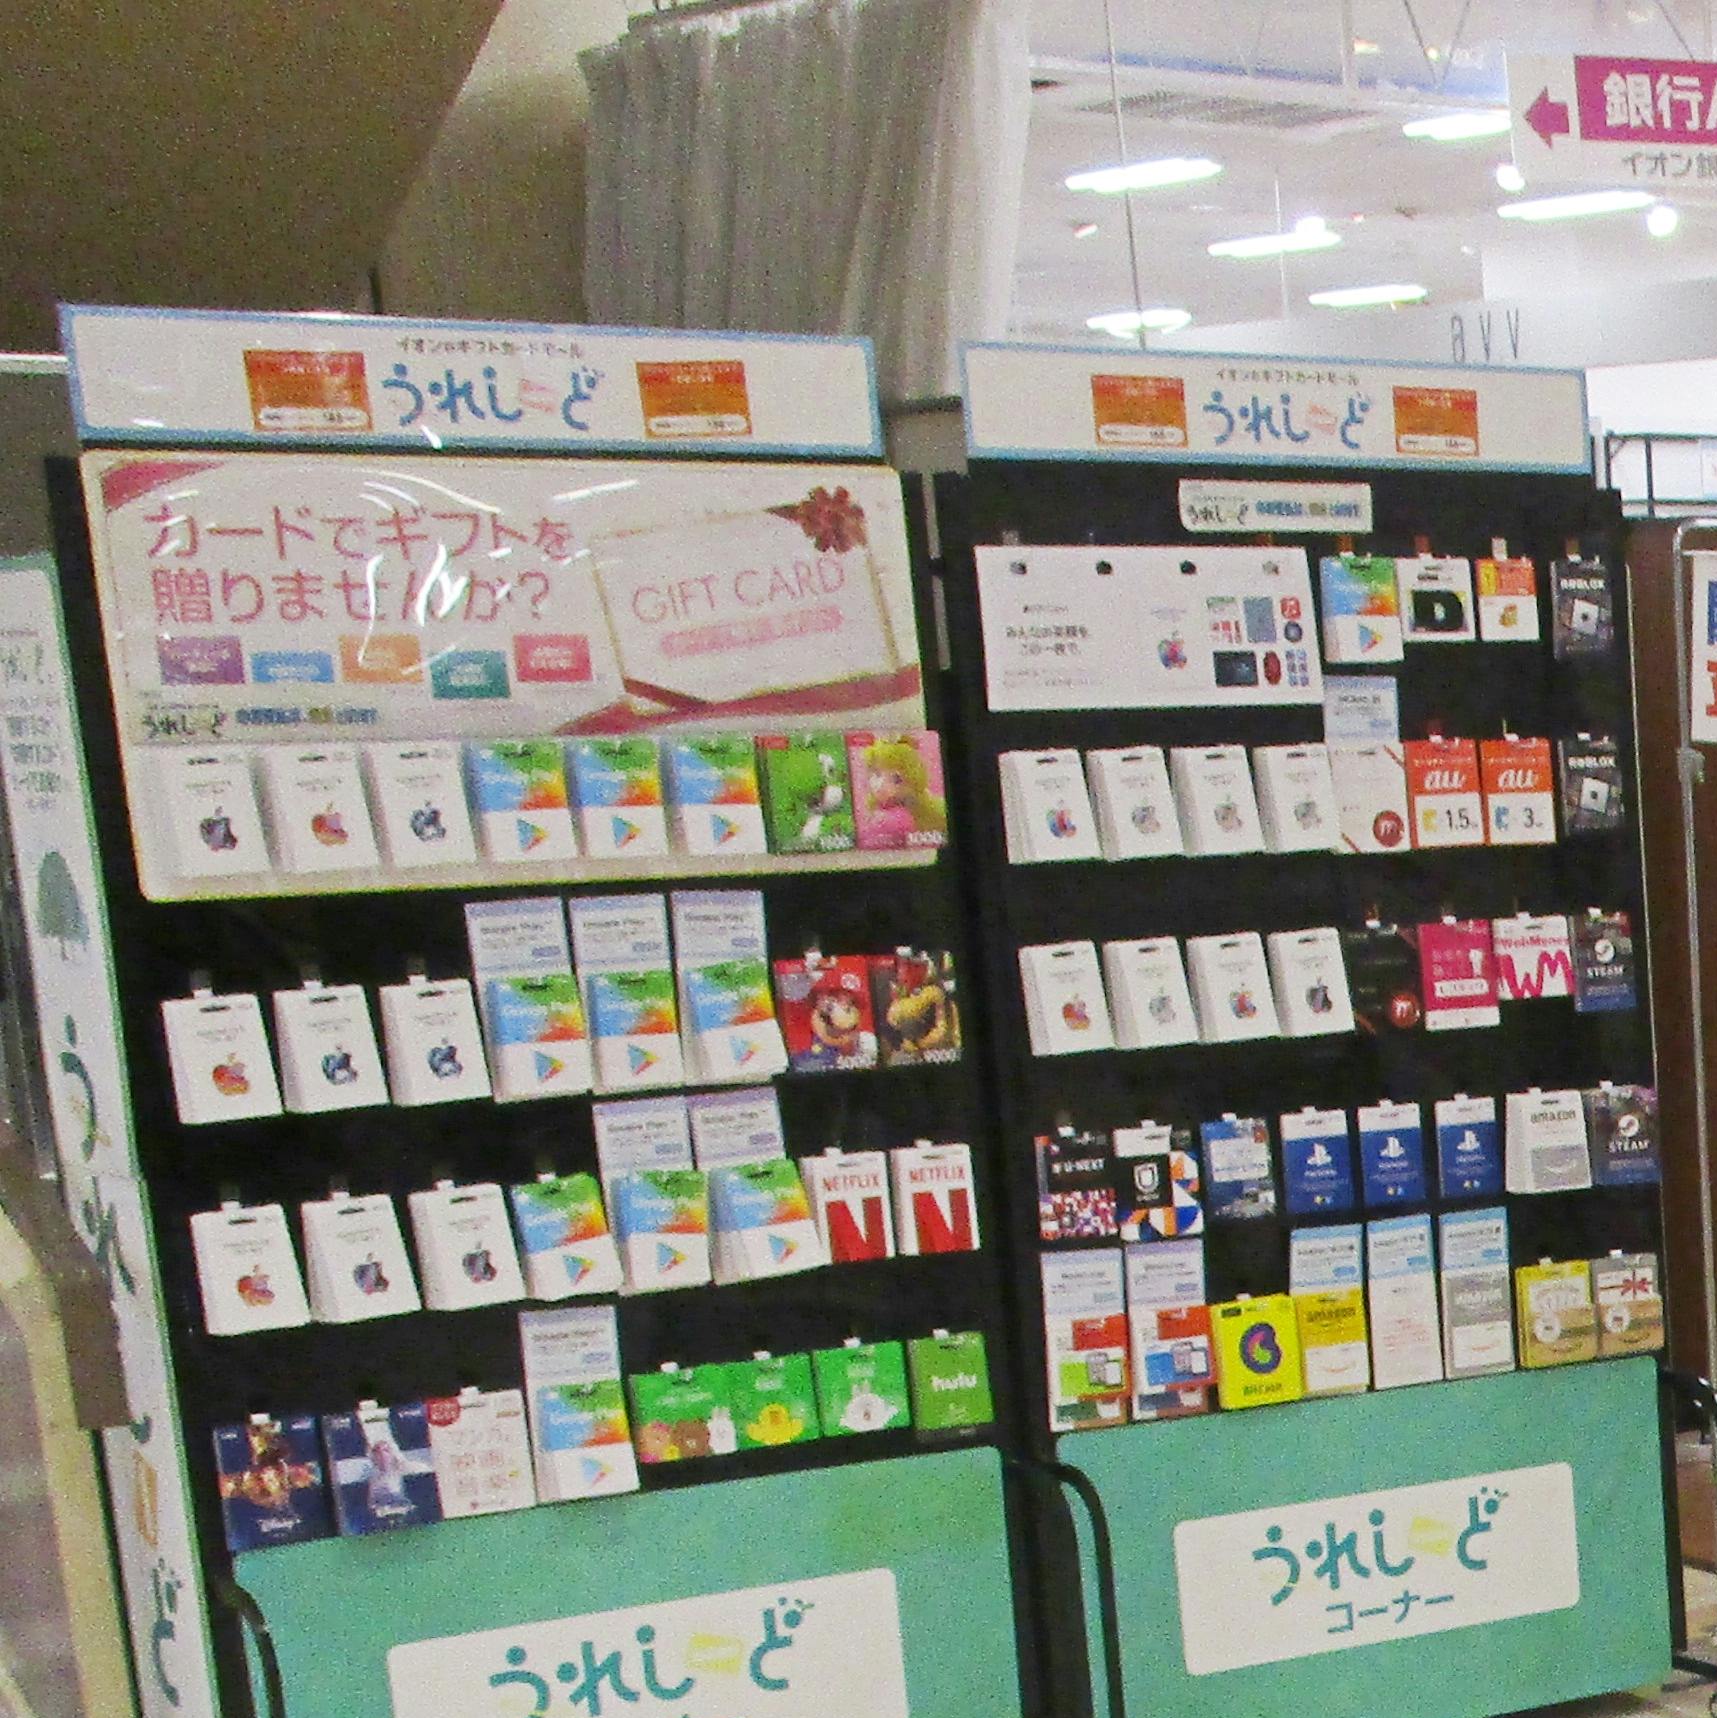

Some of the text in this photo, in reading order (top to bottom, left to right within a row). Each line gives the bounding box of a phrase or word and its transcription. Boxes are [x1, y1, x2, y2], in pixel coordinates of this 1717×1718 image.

[144, 500, 574, 562] カードでギフトを
[631, 555, 846, 625] GIFT CARD
[1424, 770, 1467, 790] au
[1498, 769, 1539, 789] au
[1608, 1139, 1650, 1153] STEAM
[823, 1172, 882, 1192] NETFLIX
[909, 1165, 966, 1185] NETFLIX
[931, 1372, 978, 1393] hulu
[1326, 1590, 1455, 1635] コーナー
